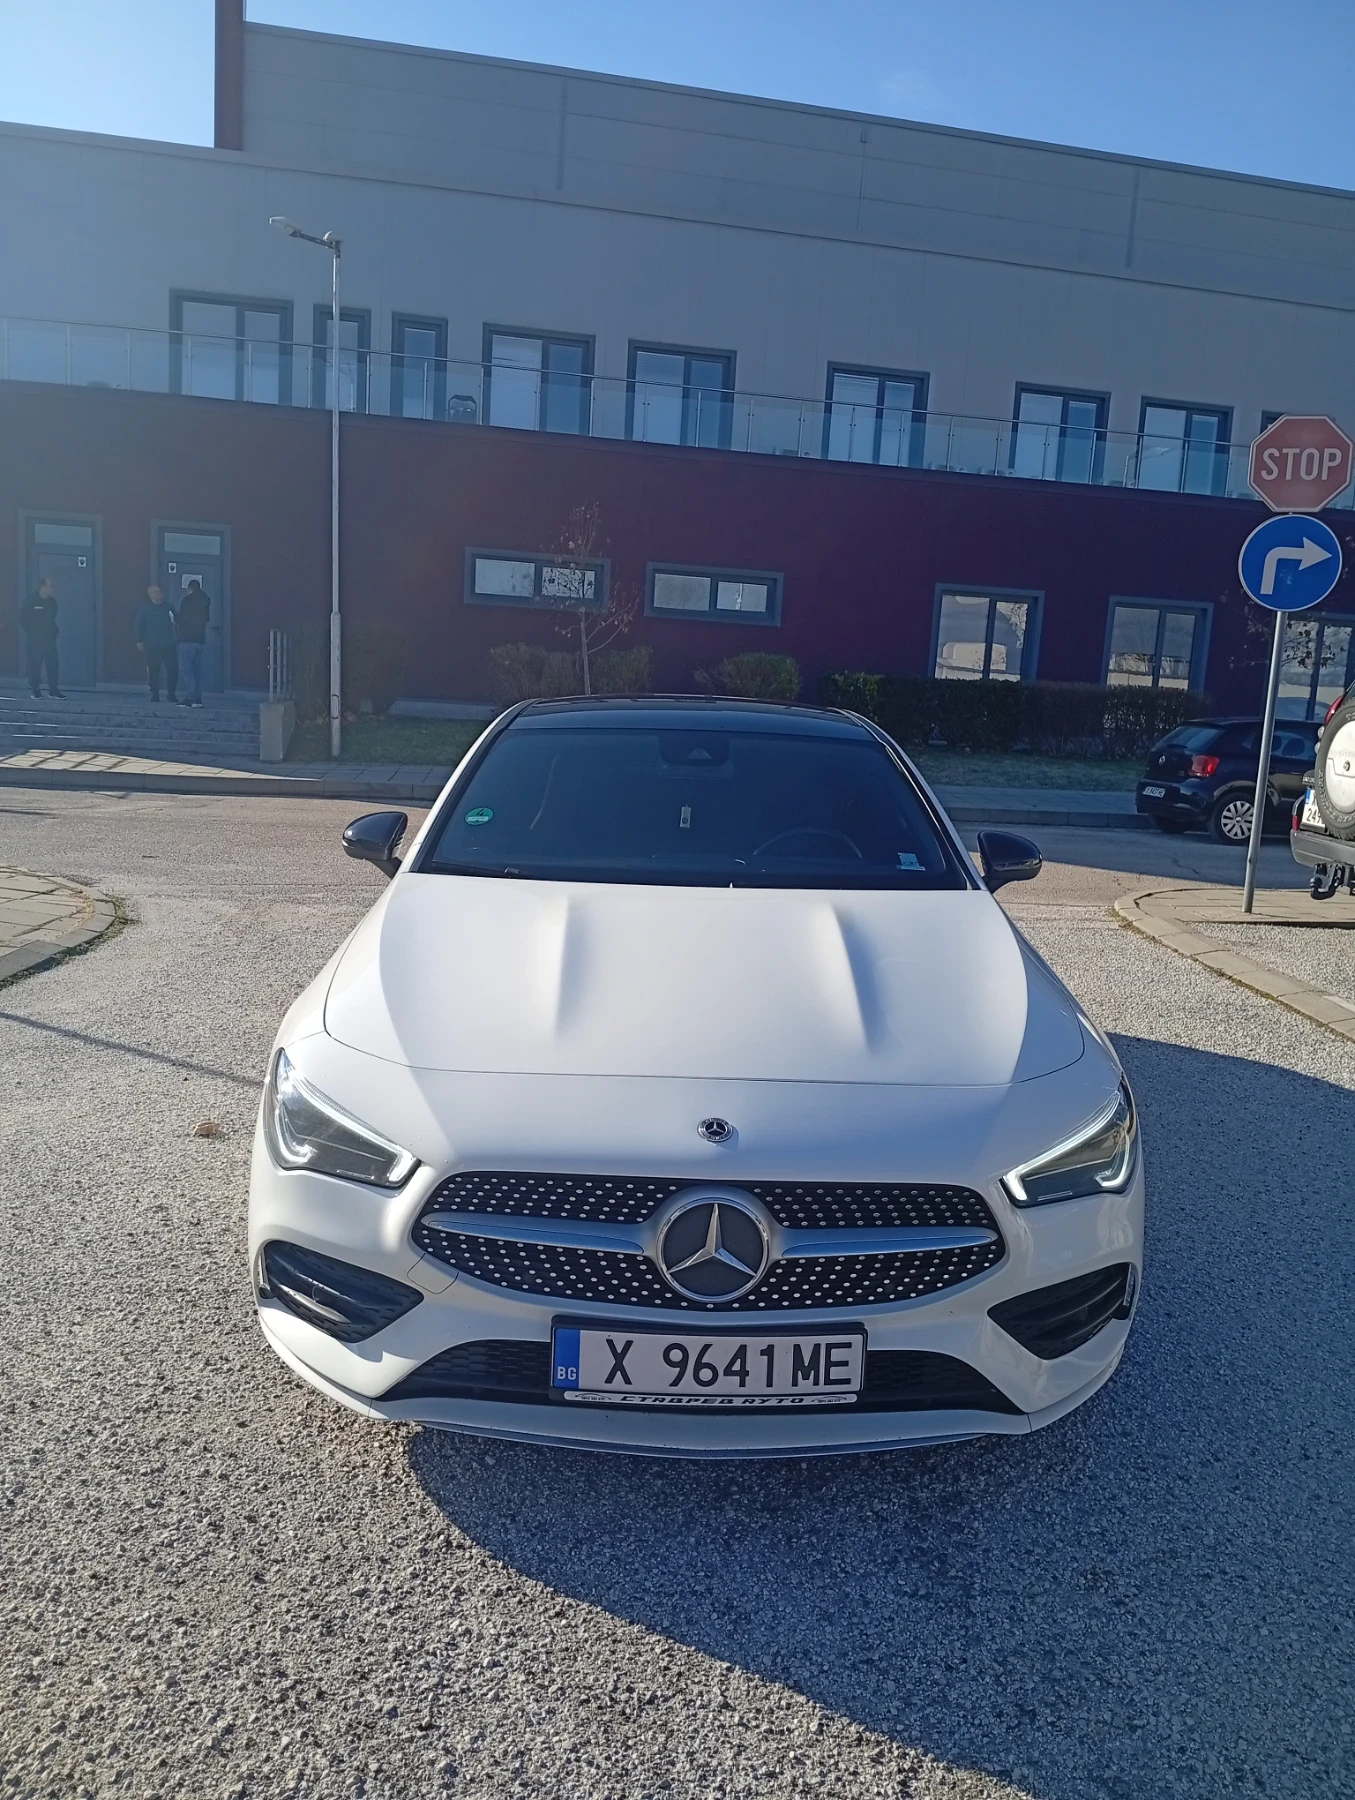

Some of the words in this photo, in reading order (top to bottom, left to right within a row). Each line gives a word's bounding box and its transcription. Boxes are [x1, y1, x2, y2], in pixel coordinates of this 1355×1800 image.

[1260, 447, 1343, 481] STOP
[557, 1365, 577, 1381] BG
[604, 1338, 634, 1385] X
[662, 1342, 775, 1388] 9641
[791, 1341, 852, 1388] ME
